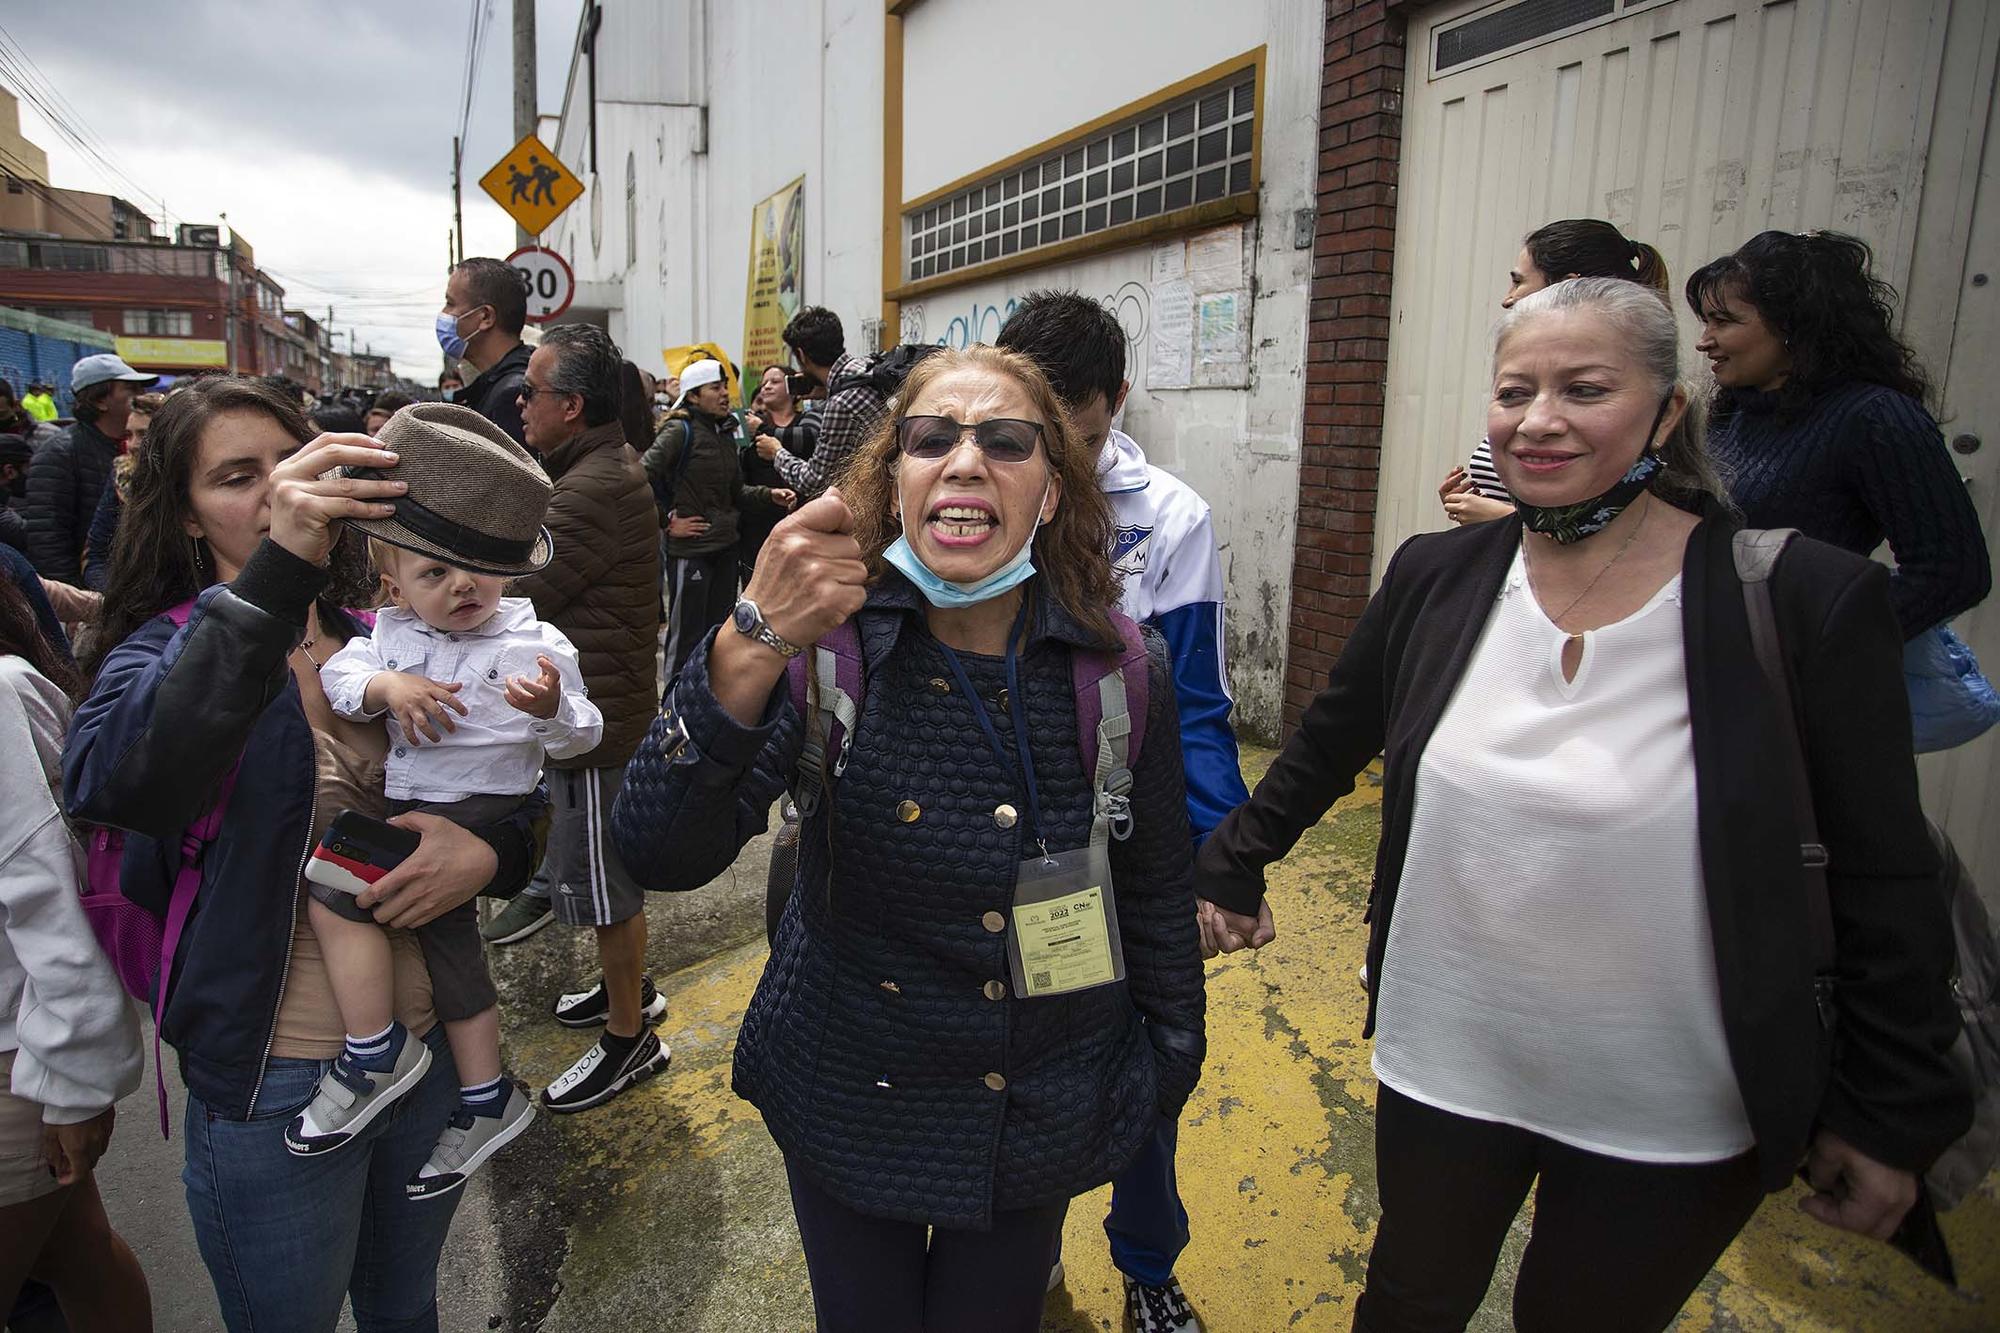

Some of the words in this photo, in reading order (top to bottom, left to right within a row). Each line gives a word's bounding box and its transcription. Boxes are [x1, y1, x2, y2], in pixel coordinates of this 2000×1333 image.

[1133, 550, 1146, 565] M
[1050, 908, 1070, 918] 2022
[560, 1046, 600, 1088] DOLCE
